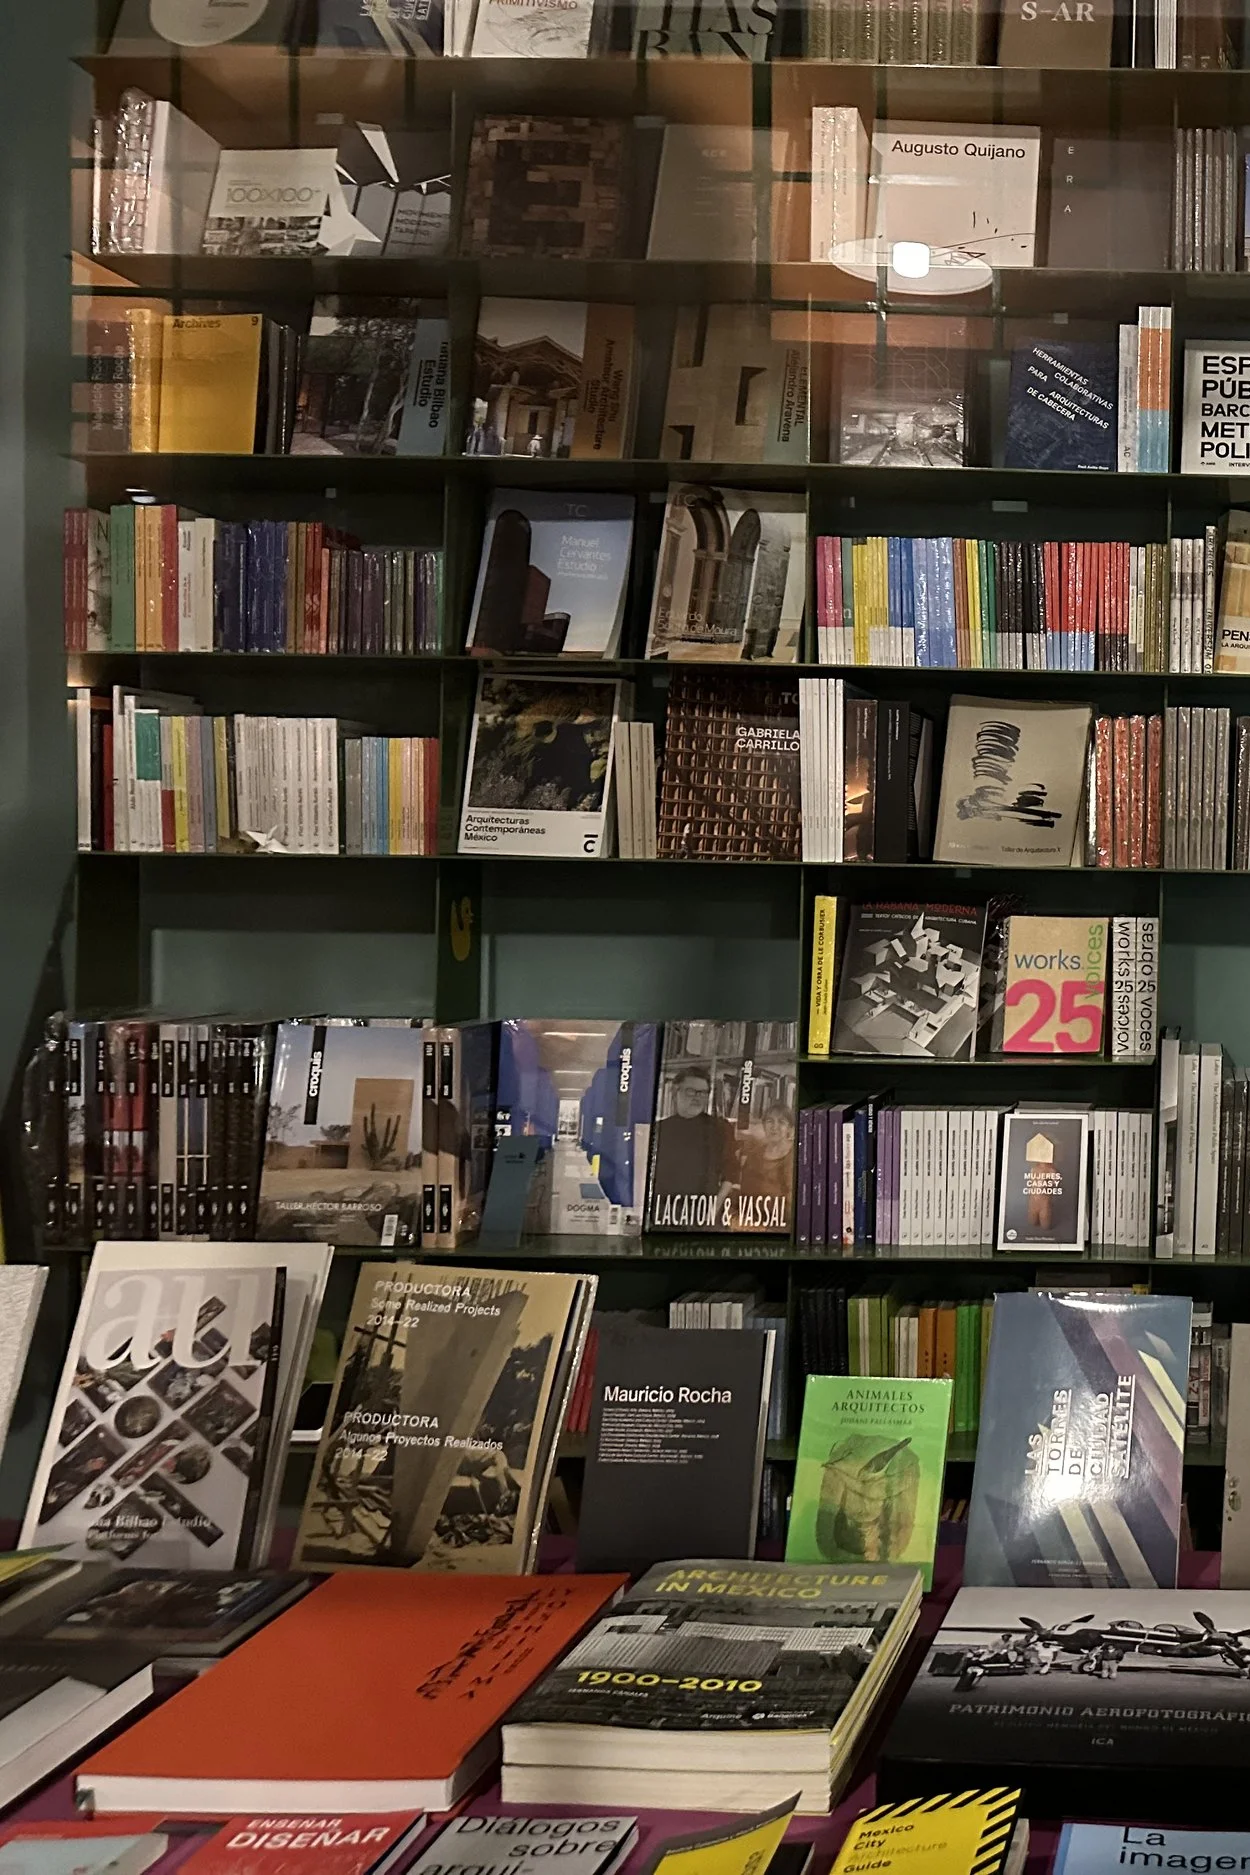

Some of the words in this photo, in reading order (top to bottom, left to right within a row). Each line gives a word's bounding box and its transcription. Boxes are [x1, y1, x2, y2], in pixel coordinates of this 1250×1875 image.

[891, 139, 958, 159] Augusto
[964, 142, 1026, 161] Quijano
[172, 318, 221, 329] Archives
[251, 316, 259, 327] 9
[113, 345, 124, 380] Rocha
[1032, 347, 1089, 385] HERRAMIENTAS
[1027, 365, 1048, 382] PARA
[418, 359, 437, 408] Estudio
[1054, 372, 1114, 410] COLABORATIVAS
[113, 383, 123, 430] Mauricio
[794, 367, 807, 428] ELEMENTAL
[1026, 386, 1037, 397] DE
[1038, 393, 1075, 421] CABECERA
[429, 387, 446, 429] Bilbao
[1049, 390, 1109, 429] ARQUITECTURAS
[781, 400, 794, 443] Aravena
[561, 535, 599, 548] Manuel
[559, 548, 611, 561] Cervantes
[557, 558, 597, 572] Estudio
[737, 727, 800, 740] GABRIELA
[736, 739, 800, 751] CARRILLO
[465, 823, 546, 834] Contemporáneas
[466, 814, 530, 825] Arquitecturas
[464, 832, 498, 842] México
[876, 903, 919, 911] HABANA
[926, 903, 977, 916] MODERNA
[1118, 922, 1134, 978] works
[1138, 923, 1154, 976] obras
[817, 956, 823, 965] DE
[1014, 949, 1080, 970] works
[1085, 924, 1104, 1000] voices
[1115, 980, 1133, 993] 25
[1138, 980, 1156, 993] 25
[1002, 979, 1105, 1051] 25
[1114, 994, 1130, 1053] voices
[1140, 997, 1153, 1051] voces
[309, 1051, 322, 1097] croquis
[620, 1047, 632, 1092] croquis
[741, 1060, 753, 1104] croquis
[1024, 1172, 1063, 1180] MUJERES,
[1022, 1187, 1063, 1195] CIUDADES
[567, 1204, 600, 1213] DOGMA
[654, 1195, 717, 1226] LACATON
[722, 1197, 731, 1226] &
[738, 1195, 787, 1227] VASSAL
[374, 1280, 471, 1297] PRODUCTORA
[371, 1298, 401, 1309] Some
[406, 1299, 450, 1313] Realized
[455, 1302, 500, 1317] Projects
[604, 1385, 674, 1403] Mauricio
[678, 1387, 732, 1403] Rocha
[846, 1389, 913, 1400] ANIMALES
[832, 1401, 925, 1413] ARQUITECTOS
[344, 1411, 439, 1428] PRODUCTORA
[339, 1432, 381, 1444] Algunos
[385, 1433, 440, 1447] Proyectos
[445, 1435, 503, 1451] Realizados
[1048, 1390, 1067, 1475] TORRES
[1090, 1393, 1109, 1476] CIUDAD
[1025, 1433, 1043, 1475] LAS
[1069, 1448, 1082, 1475] DE
[664, 1568, 889, 1586] ARCHITECTURE
[656, 1581, 690, 1593] IN
[698, 1582, 822, 1599] MEXICO
[700, 1712, 743, 1720] Arquine
[949, 1703, 1074, 1717] PATRIMONIO
[1091, 1737, 1115, 1746] ICA
[457, 1816, 622, 1838] Diálogos
[859, 1824, 915, 1839] Mexico
[1123, 1826, 1165, 1846] La
[508, 1837, 620, 1859] sobre
[850, 1840, 948, 1862] Architecture
[853, 1838, 887, 1851] City
[843, 1859, 892, 1874] Guide
